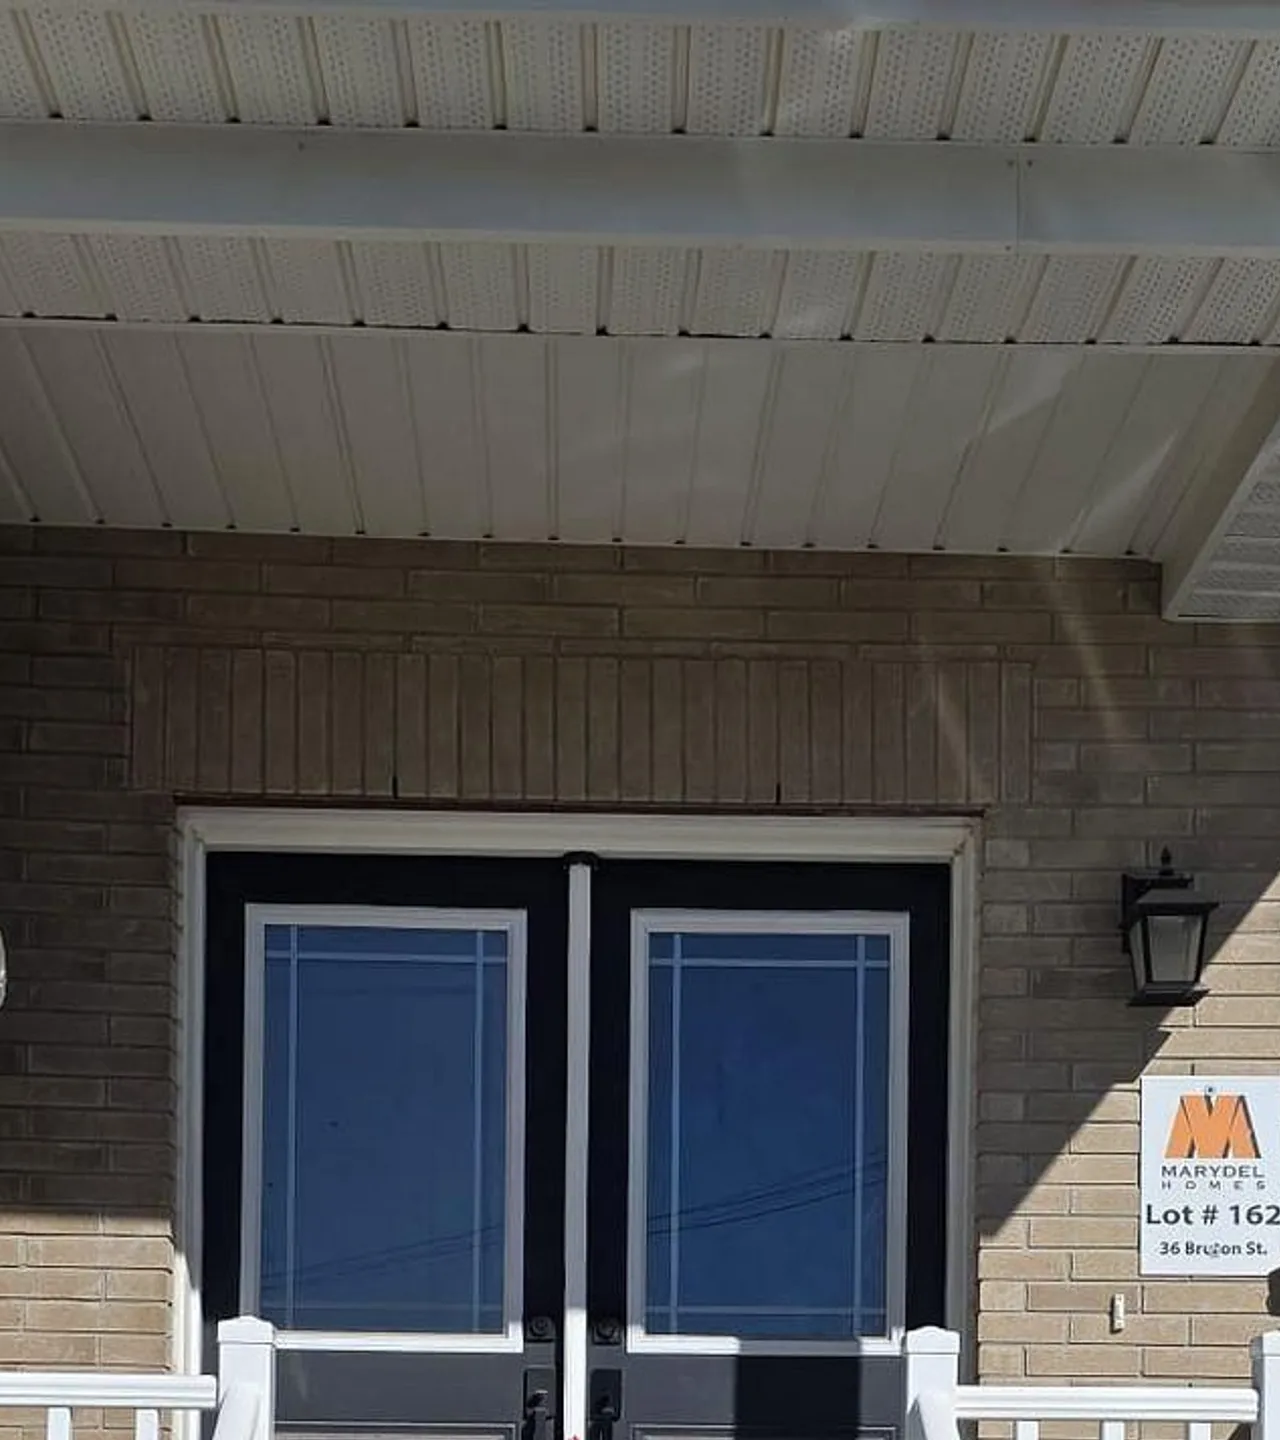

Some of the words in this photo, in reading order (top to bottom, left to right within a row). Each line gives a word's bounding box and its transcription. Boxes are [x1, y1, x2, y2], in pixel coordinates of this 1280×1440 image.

[1161, 1165, 1265, 1178] MARYDEL
[1146, 1203, 1192, 1225] Lot
[1202, 1204, 1219, 1225] #
[1159, 1241, 1180, 1256] 36
[1246, 1240, 1268, 1256] St.
